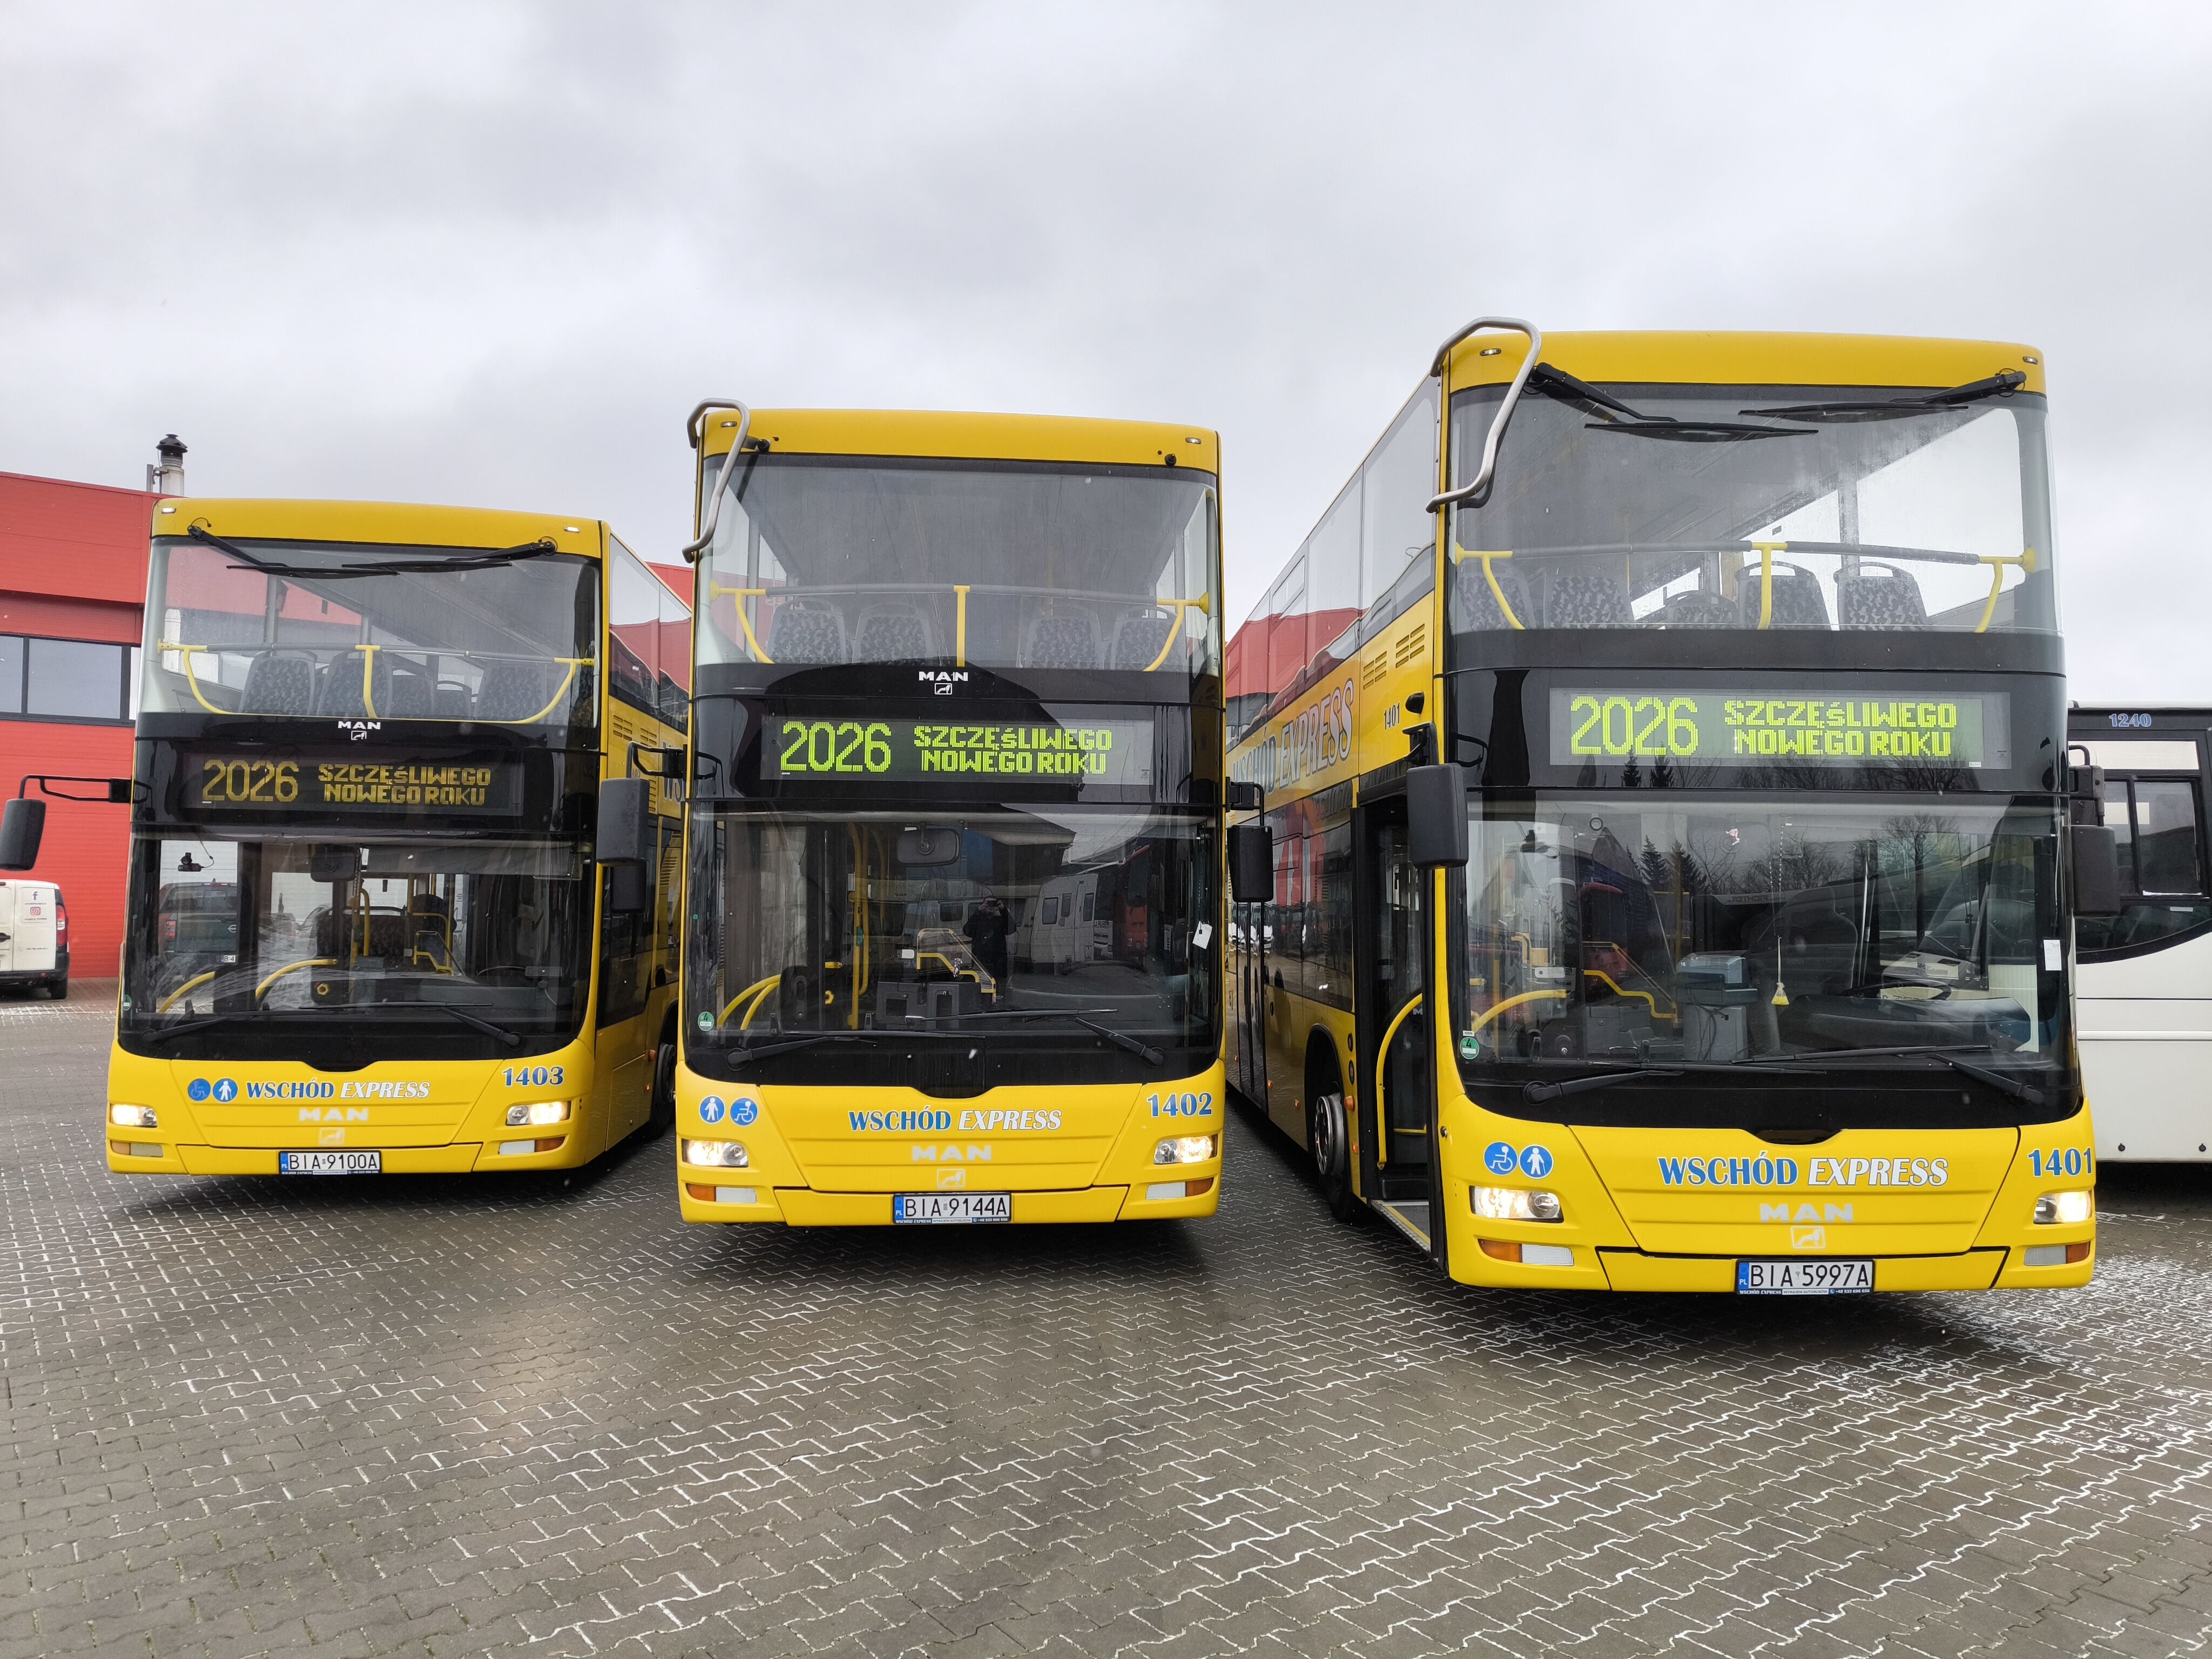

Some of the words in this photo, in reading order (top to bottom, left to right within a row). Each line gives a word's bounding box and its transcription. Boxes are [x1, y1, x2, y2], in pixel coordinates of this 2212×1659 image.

[919, 671, 968, 682] MAN
[338, 721, 381, 730] MAN
[1384, 702, 1400, 730] 1401
[1570, 696, 1698, 755] 2026
[2109, 713, 2152, 727] 1240
[1279, 678, 1354, 790] EXPRESS
[1734, 729, 1864, 755] NOWEGO
[1870, 730, 1951, 756] ROKU
[780, 721, 891, 772] 2026
[921, 750, 1032, 773] NOWEGO
[1037, 752, 1107, 774] ROKU
[202, 759, 299, 802] 2026
[324, 784, 421, 804] NOWEGO
[424, 786, 485, 806] ROKU
[703, 1013, 708, 1021] 4
[1466, 1038, 1472, 1048] 4
[502, 1065, 564, 1087] 1403
[247, 1078, 334, 1098] WSCHÓD
[340, 1081, 430, 1098] EXPRESS
[298, 1108, 368, 1121] MAN
[1147, 1092, 1213, 1117] 1402
[848, 1106, 952, 1132] WSCHÓD
[957, 1109, 1062, 1131] EXPRESS
[289, 1154, 321, 1169] BIA
[327, 1154, 377, 1169] 9100A
[912, 1145, 992, 1161] MAN
[2027, 1148, 2093, 1177] 1401
[1658, 1151, 1798, 1186] WSCHÓD
[1807, 1157, 1948, 1186] EXPRESS
[905, 1198, 941, 1217] BIA
[949, 1197, 1007, 1216] 9144A
[1759, 1203, 1854, 1222] MAN
[1751, 1265, 1793, 1287] BIA
[1802, 1264, 1869, 1286] 5997A
